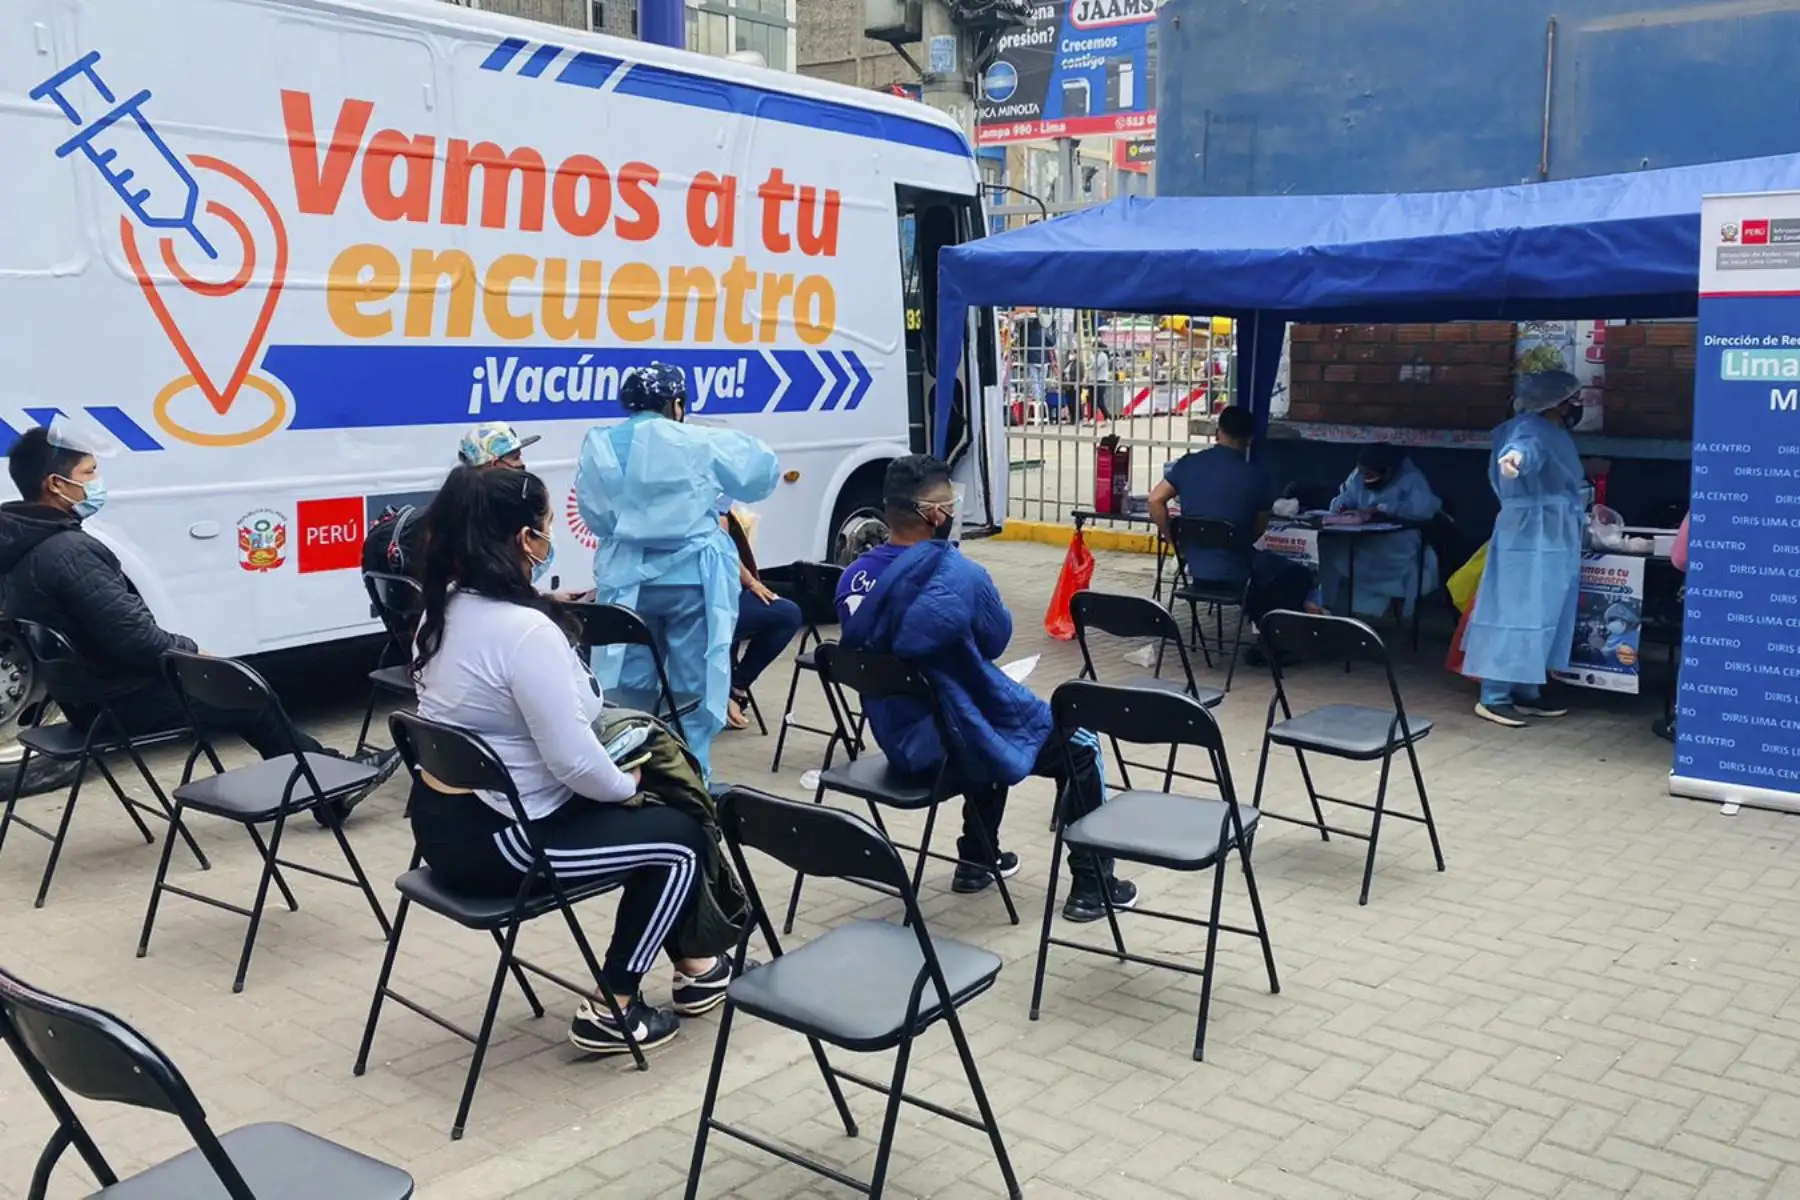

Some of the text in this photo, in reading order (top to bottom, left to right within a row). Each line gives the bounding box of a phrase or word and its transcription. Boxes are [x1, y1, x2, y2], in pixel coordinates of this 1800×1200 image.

[1077, 0, 1155, 21] JAAMS
[997, 25, 1055, 52] presión?
[1061, 36, 1118, 53] Crecemos
[1061, 53, 1106, 70] contigo
[998, 103, 1040, 118] MINOLTA
[1040, 121, 1066, 134] Lima
[280, 89, 840, 256] Vamos a tu
[325, 243, 836, 344] encuentro
[1704, 334, 1759, 346] Dirección
[1763, 334, 1778, 346] de
[1726, 351, 1798, 377] Lima
[468, 354, 747, 414] ¡Vacún ya!
[1770, 388, 1798, 410] M
[1709, 443, 1751, 453] CENTRO
[1734, 466, 1761, 476] DIRIS
[1763, 468, 1791, 477] LIMA
[1707, 491, 1748, 502] CENTRO
[1732, 515, 1759, 525] DIRIS
[1761, 517, 1788, 527] LIMA
[307, 519, 357, 546] PERÚ
[1705, 540, 1746, 551] CENTRO
[1772, 544, 1800, 554] DIRIS
[1580, 565, 1606, 576] mos
[1730, 564, 1757, 575] DIRIS
[1760, 567, 1785, 577] LIMA
[1702, 588, 1743, 599] CENTRO
[1770, 593, 1797, 604] DIRIS
[1727, 612, 1754, 624] DIRIS
[1756, 615, 1783, 626] LIMA
[1700, 636, 1741, 648] CENTRO
[1767, 642, 1794, 654] DIRIS
[1725, 660, 1751, 673] DIRIS
[1754, 664, 1780, 675] LIMA
[1697, 684, 1738, 697] CENTRO
[1764, 691, 1792, 703] DIRIS
[1722, 712, 1749, 724] DIRIS
[1751, 716, 1777, 727] LIMA
[1695, 734, 1735, 748] CENTRO
[1762, 743, 1789, 755] DIRIS
[1719, 760, 1746, 772] DIRIS
[1748, 765, 1775, 777] LIMA
